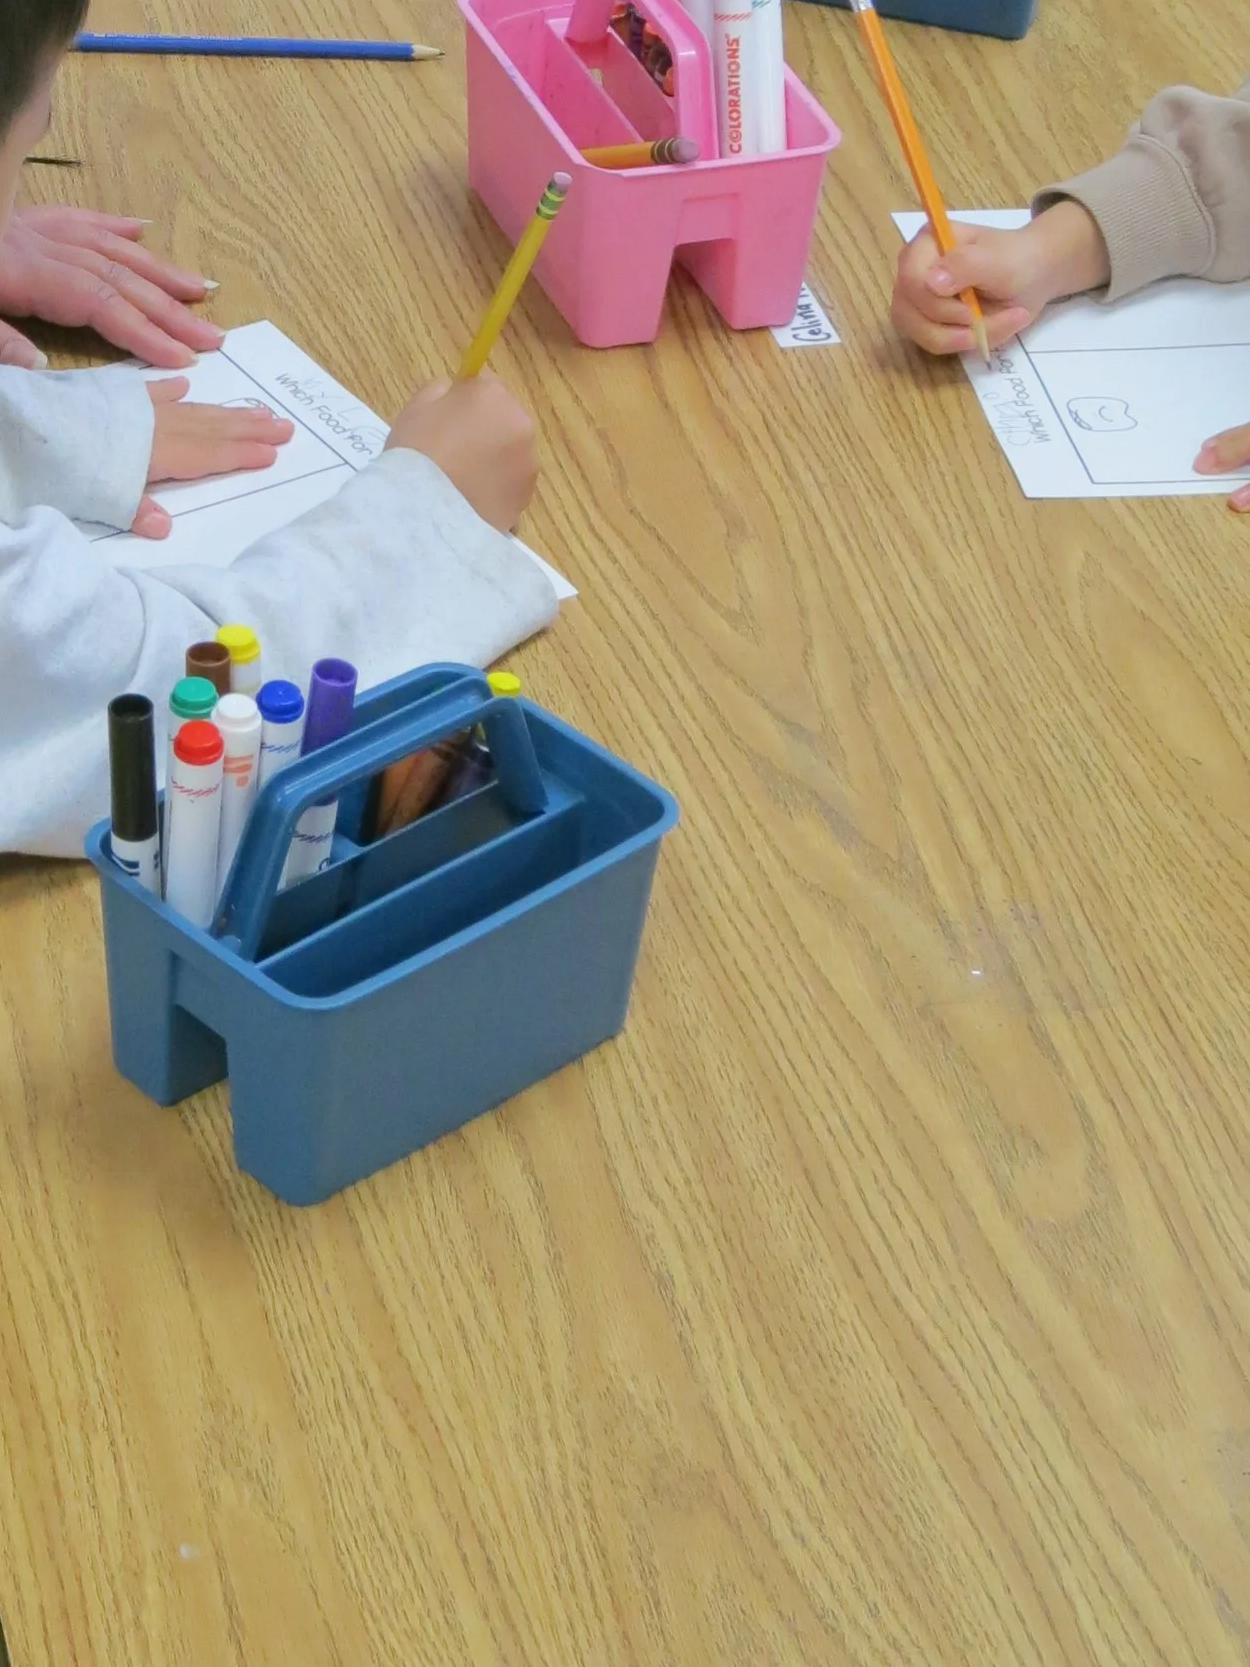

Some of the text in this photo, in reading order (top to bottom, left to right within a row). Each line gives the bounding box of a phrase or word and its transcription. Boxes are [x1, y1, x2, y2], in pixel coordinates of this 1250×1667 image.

[726, 36, 742, 154] COLORATIONS
[791, 302, 832, 342] Celina
[997, 354, 1019, 375] For
[1004, 377, 1034, 407] Food
[275, 373, 373, 455] Which Food For
[1022, 410, 1051, 443] Which
